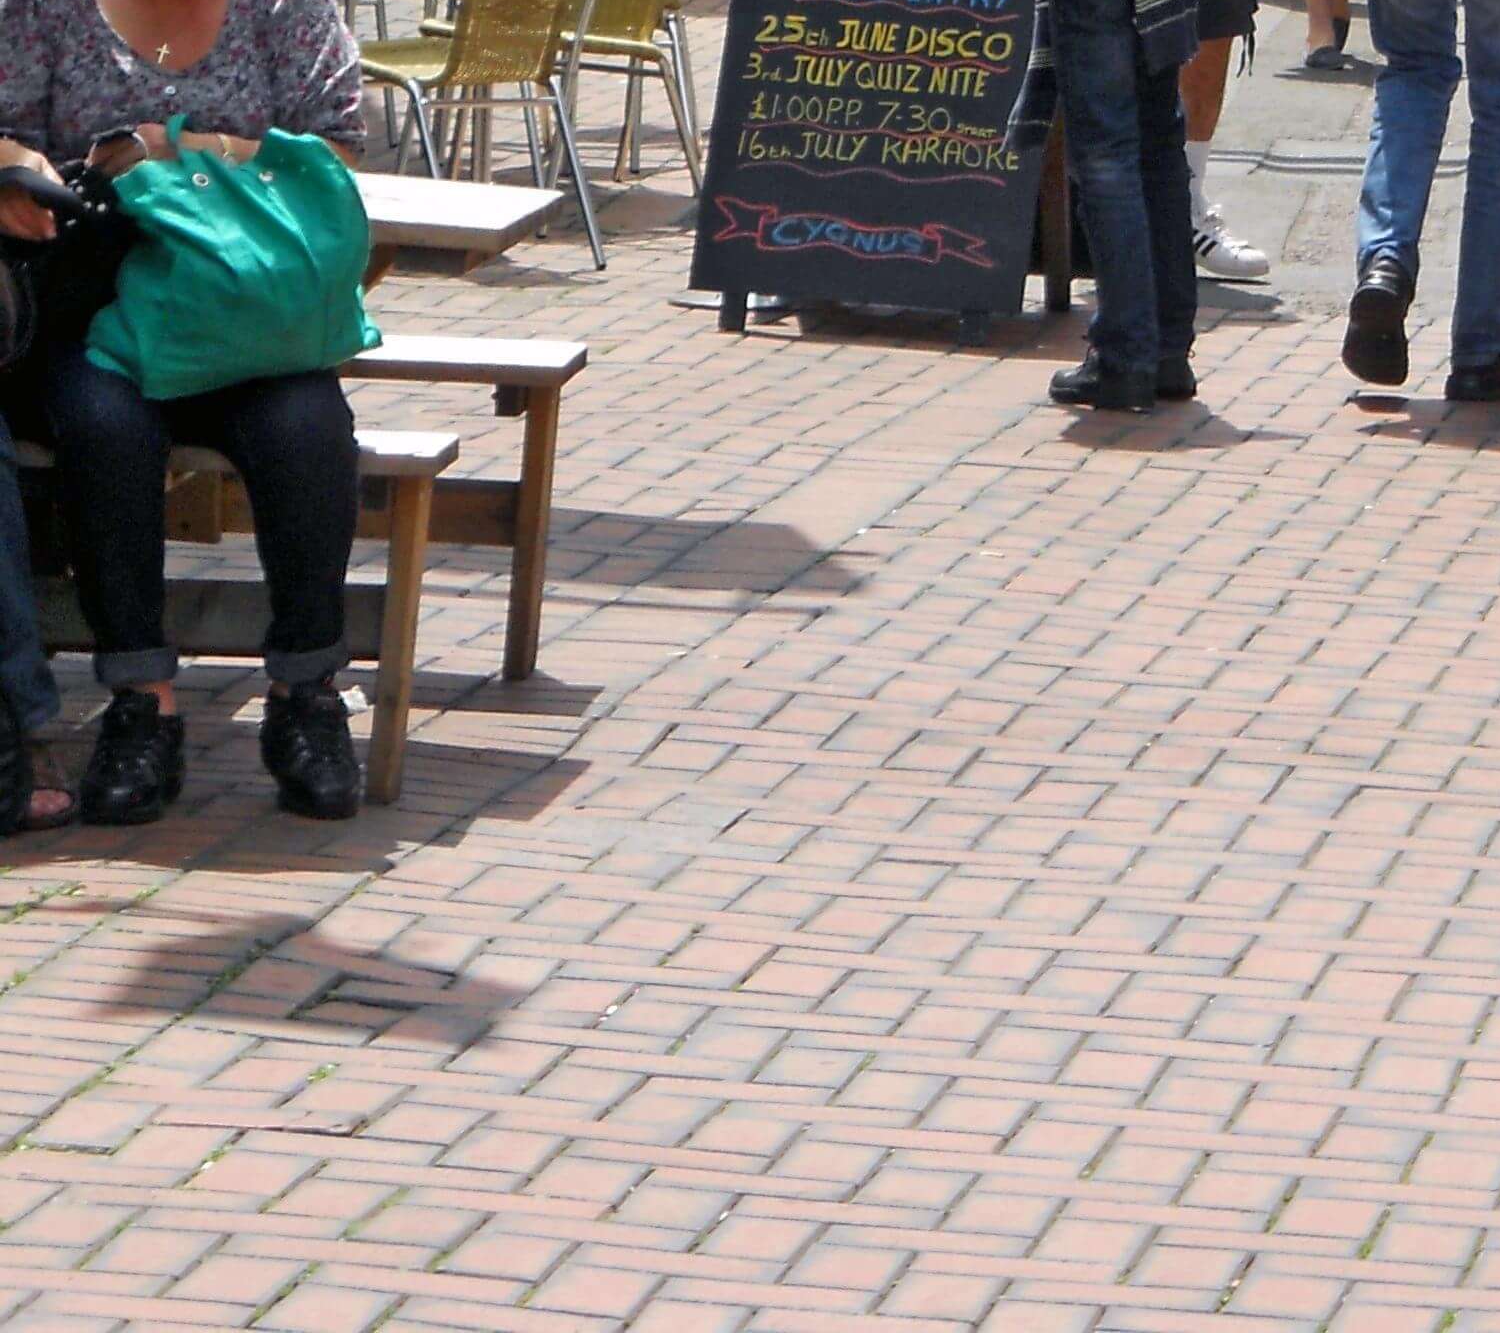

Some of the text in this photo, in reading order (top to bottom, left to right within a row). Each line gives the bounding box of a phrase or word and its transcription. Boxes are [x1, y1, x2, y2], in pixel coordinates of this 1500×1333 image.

[754, 14, 1013, 61] 25th JUNE DISCO
[742, 52, 991, 98] 3rd JULY QUIZ NITE
[737, 130, 1020, 171] 16th JULY KARAOKE
[771, 217, 924, 254] CYGNUS
